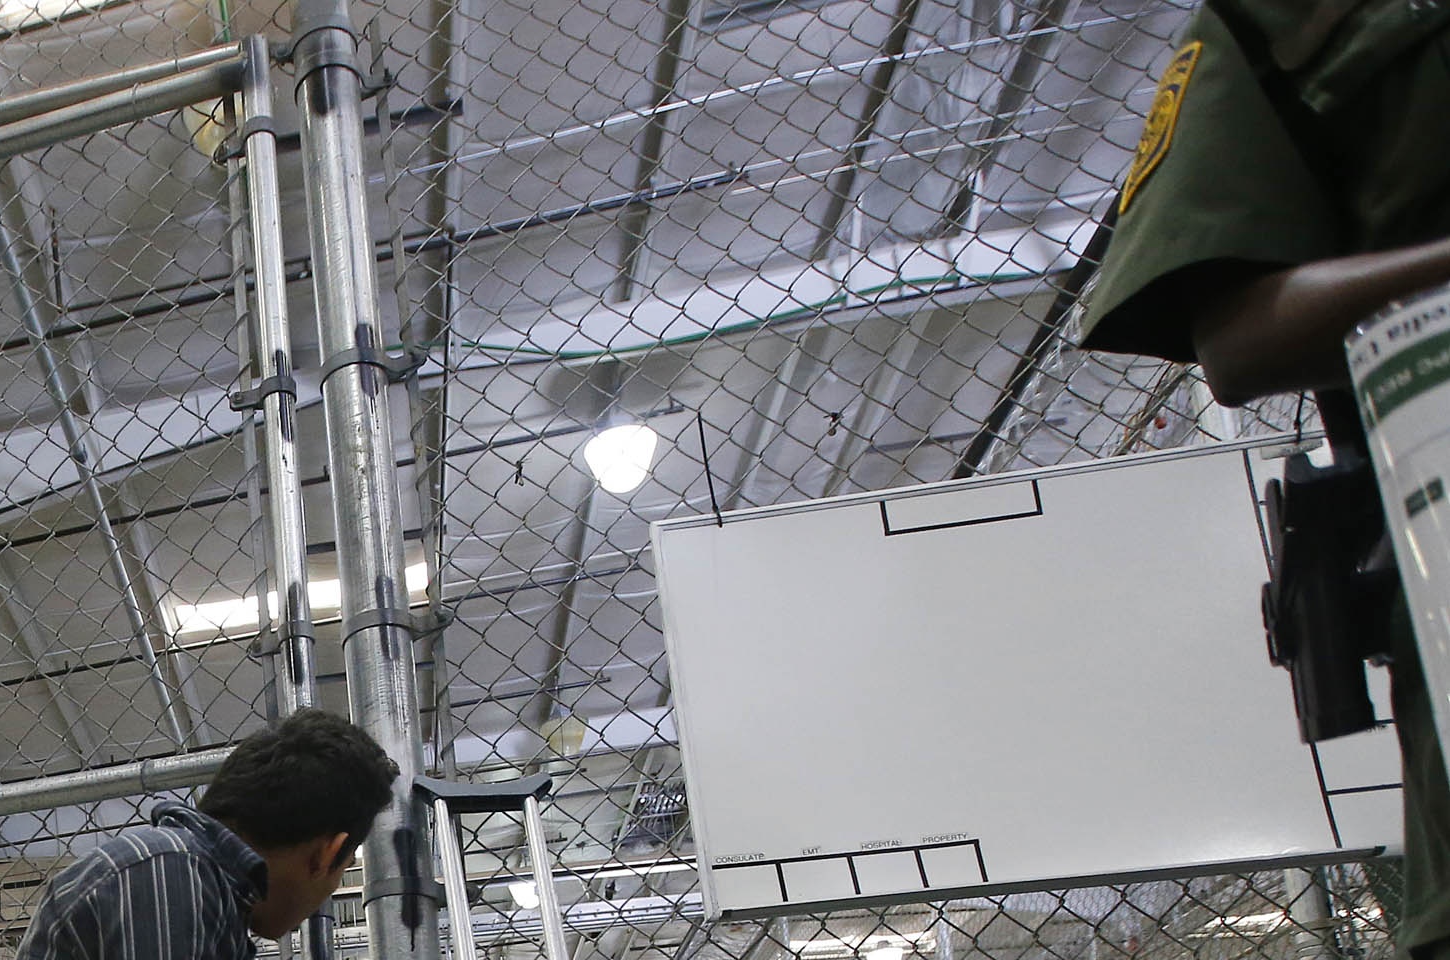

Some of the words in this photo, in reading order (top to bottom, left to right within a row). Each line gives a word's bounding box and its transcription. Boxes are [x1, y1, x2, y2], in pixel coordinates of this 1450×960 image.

[922, 833, 968, 843] PROPERTY
[861, 839, 903, 850] HOSPITAL
[802, 847, 821, 856] EMT
